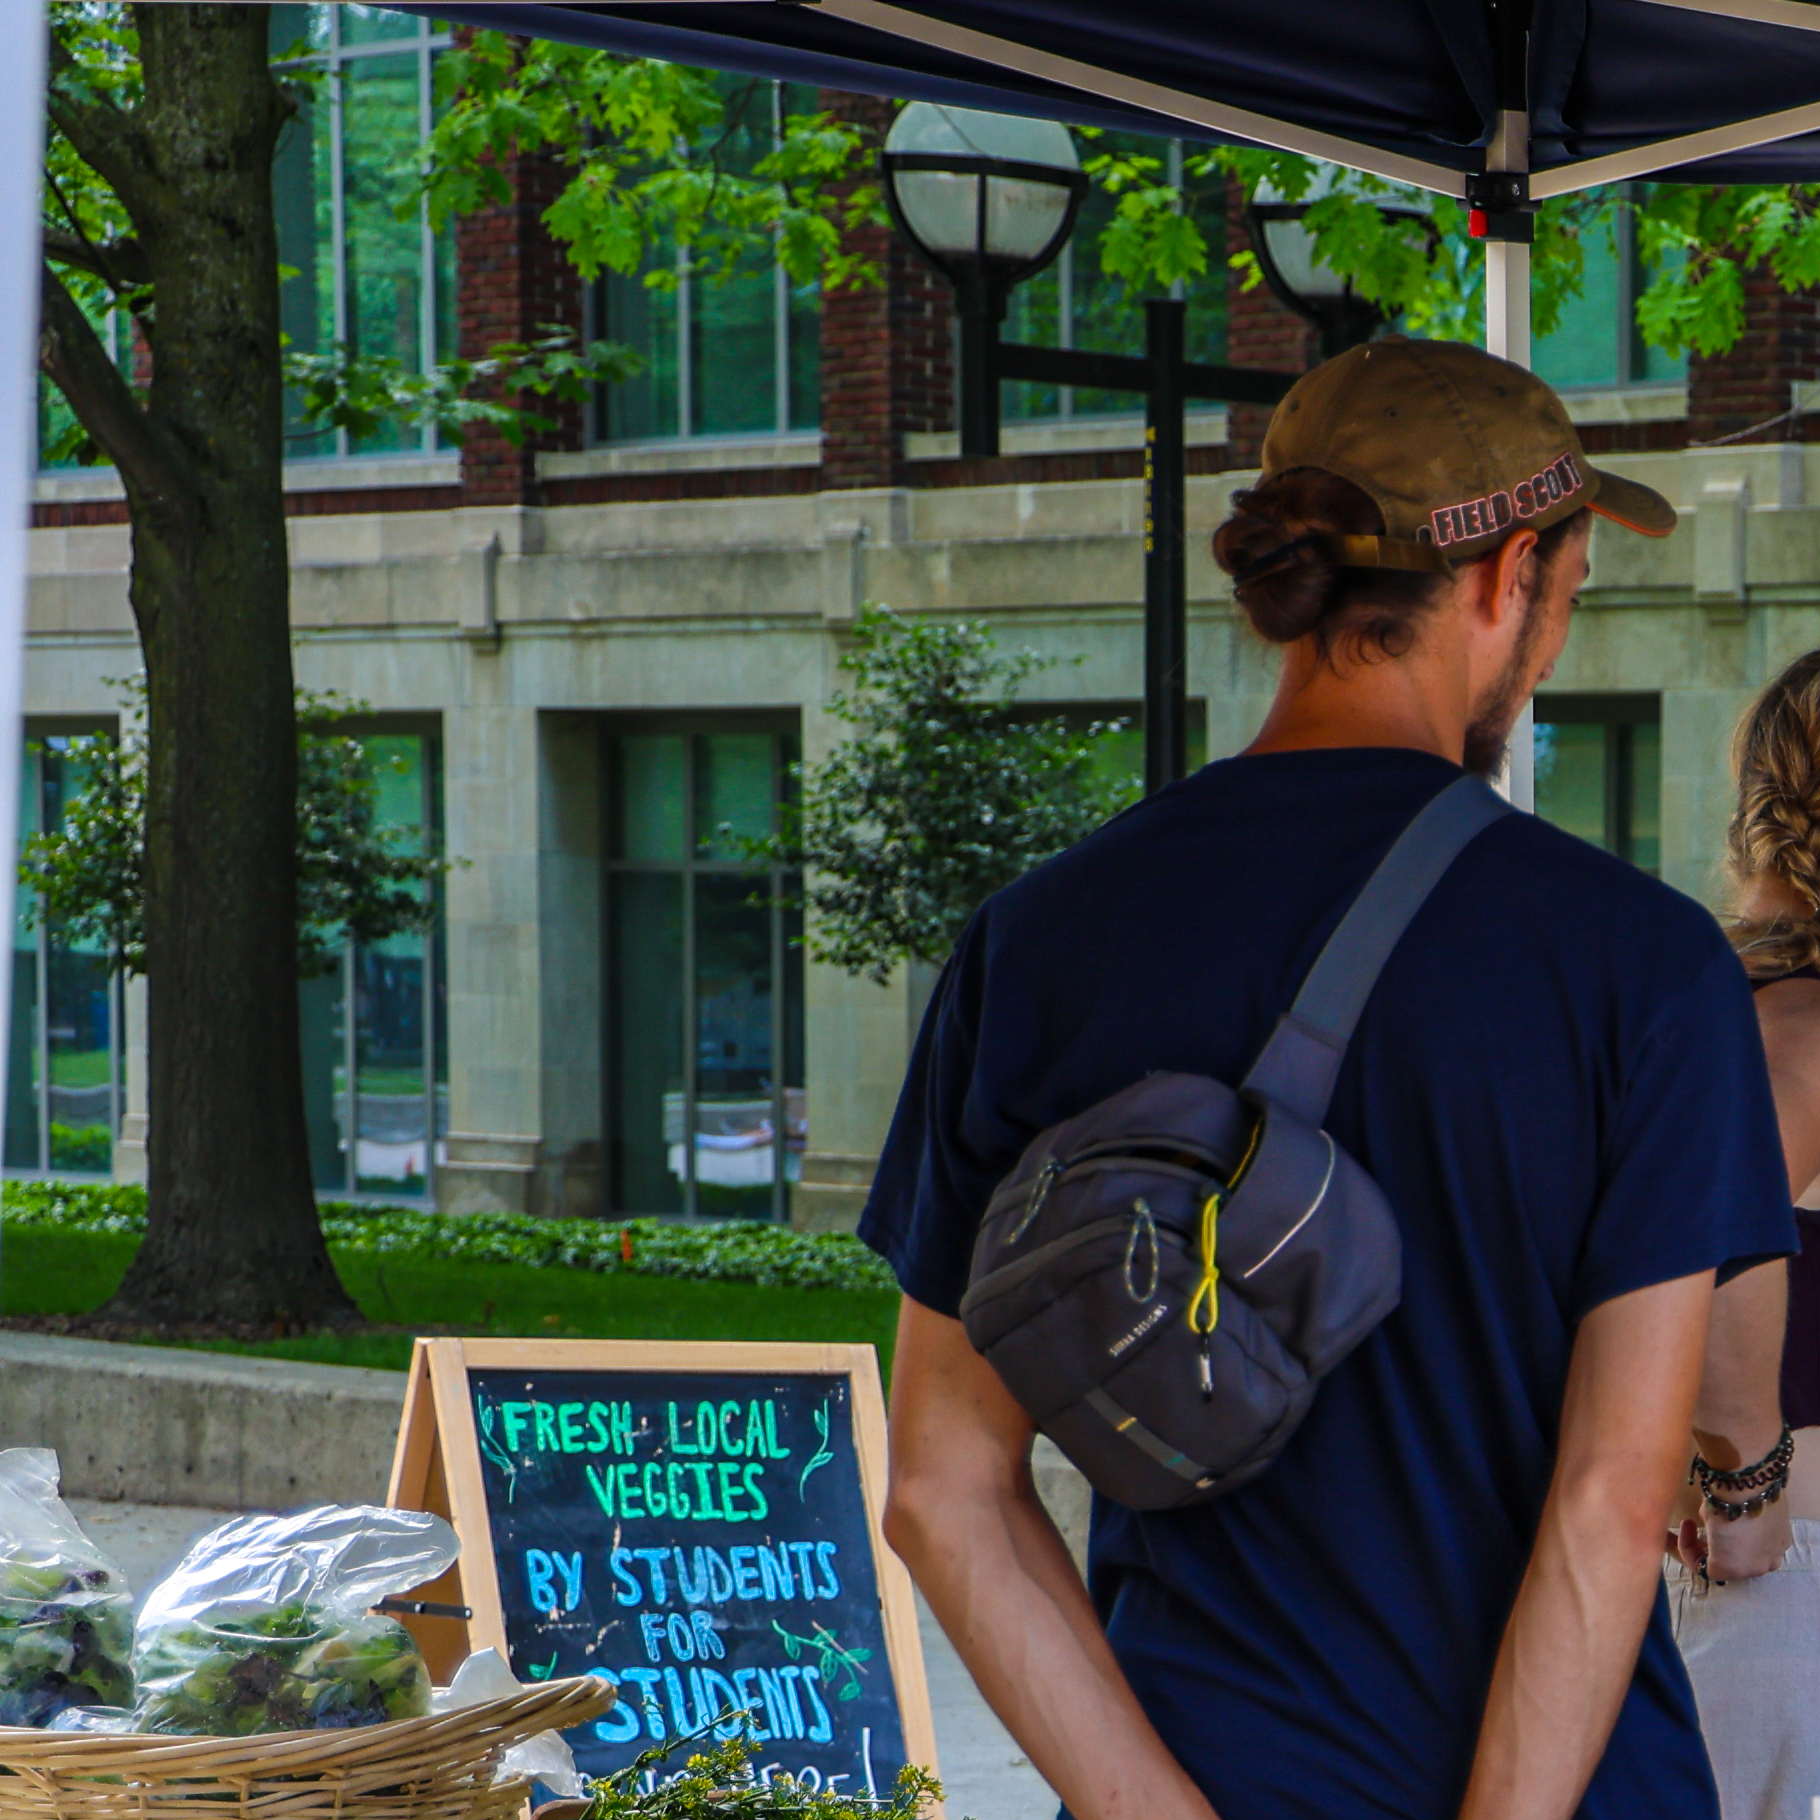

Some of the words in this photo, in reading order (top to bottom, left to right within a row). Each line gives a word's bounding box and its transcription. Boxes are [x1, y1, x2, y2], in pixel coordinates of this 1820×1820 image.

[1431, 490, 1513, 546] FIELD
[1514, 451, 1583, 519] SCOUT
[501, 1400, 633, 1457] FRESH
[668, 1399, 791, 1459] LOCAL
[586, 1461, 769, 1522] VEGGIES
[526, 1548, 583, 1613] BY
[610, 1541, 841, 1607] STUDENTS
[640, 1610, 726, 1663] FOR
[587, 1665, 833, 1744] STUDENTS
